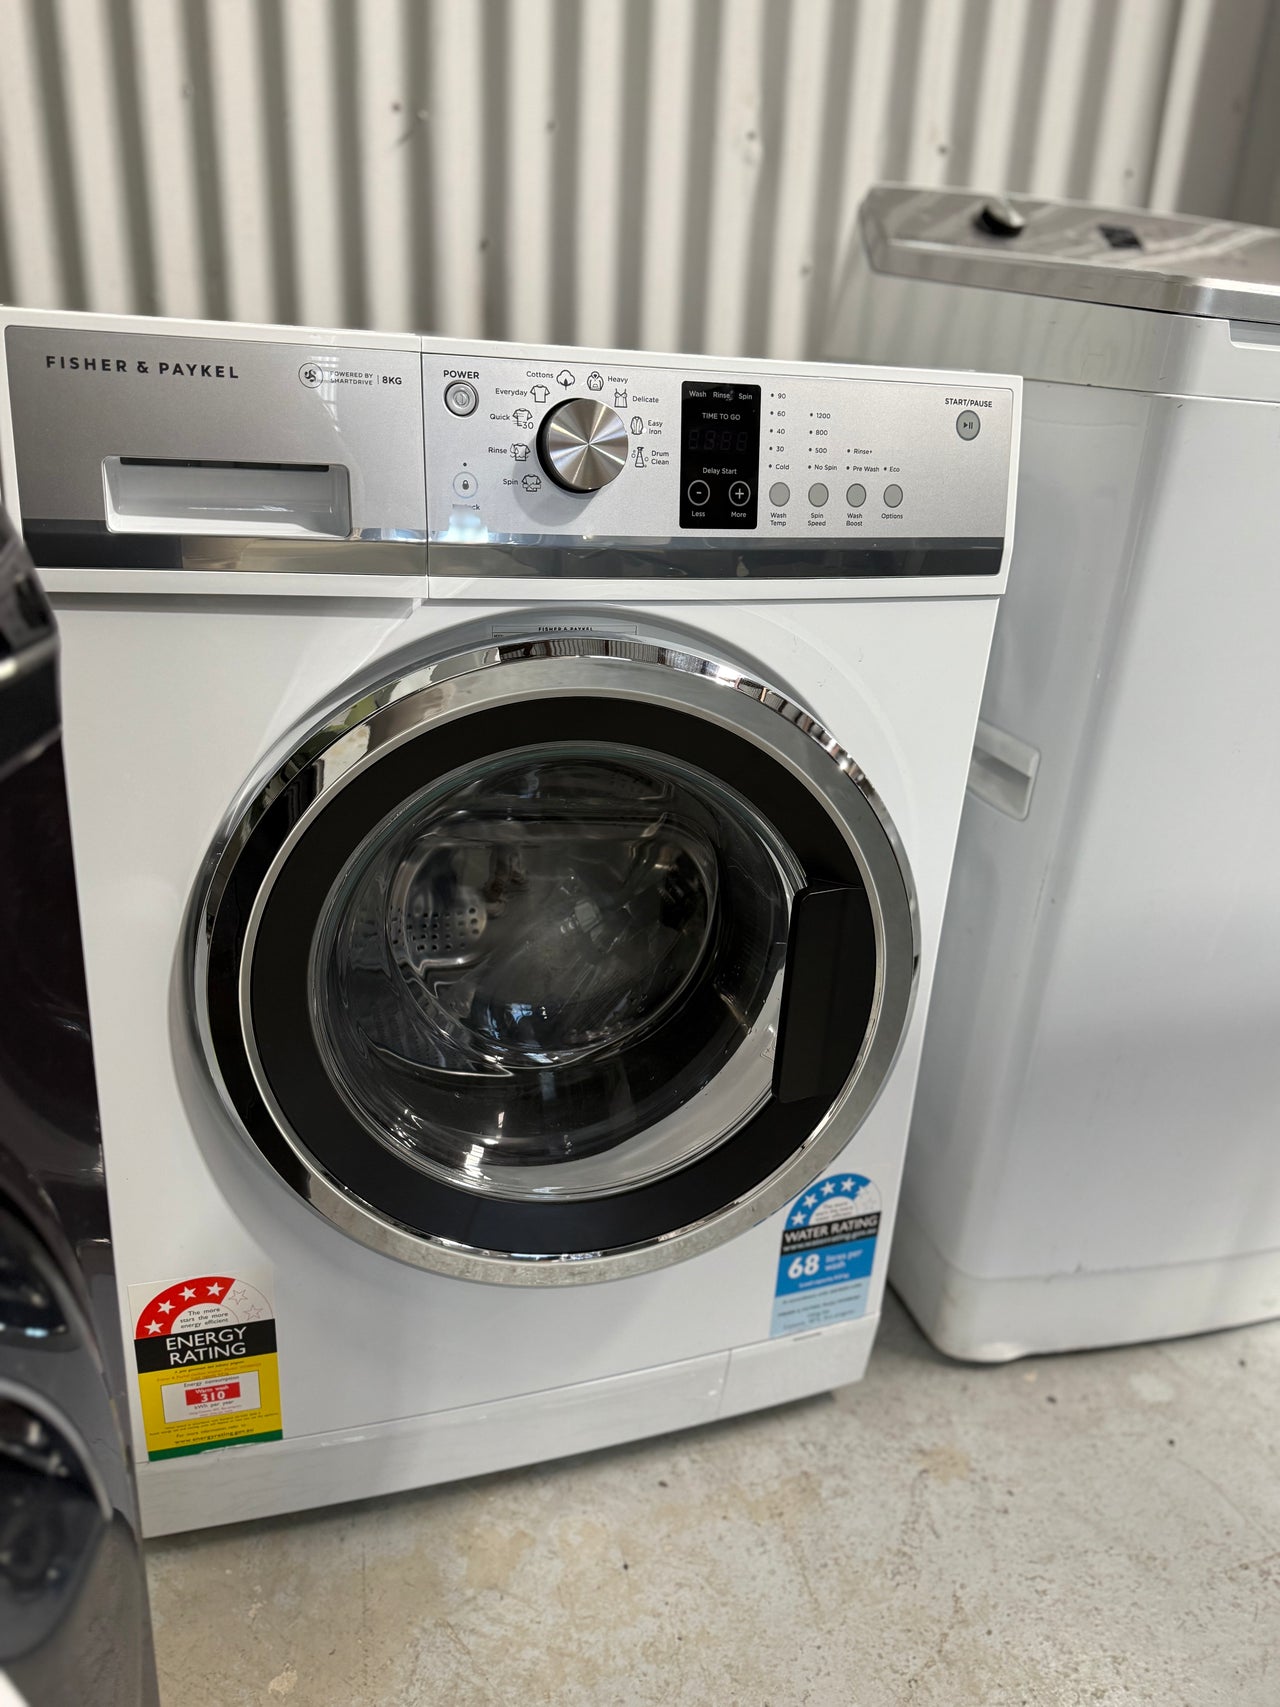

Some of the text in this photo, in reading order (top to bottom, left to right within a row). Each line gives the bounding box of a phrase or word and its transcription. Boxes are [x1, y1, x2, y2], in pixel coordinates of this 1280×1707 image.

[46, 356, 239, 378] FISHER & PAYKEL
[443, 370, 479, 379] POWER
[526, 371, 554, 379] Cottons
[382, 376, 402, 385] 8KG
[607, 376, 628, 384] Heavy
[495, 388, 528, 397] Everyday
[689, 390, 707, 398] Wash
[713, 391, 731, 399] Rinse
[945, 398, 992, 408] START/PAUSE
[490, 413, 510, 421] Quick
[648, 420, 663, 428] Easy
[702, 467, 720, 475] Delay
[881, 512, 903, 520] Options
[785, 1225, 829, 1243] WATER
[831, 1215, 878, 1234] RATING
[788, 1254, 820, 1279] 68
[166, 1326, 247, 1351] ENERGY
[170, 1342, 246, 1366] RATING
[201, 1391, 226, 1403] 310
